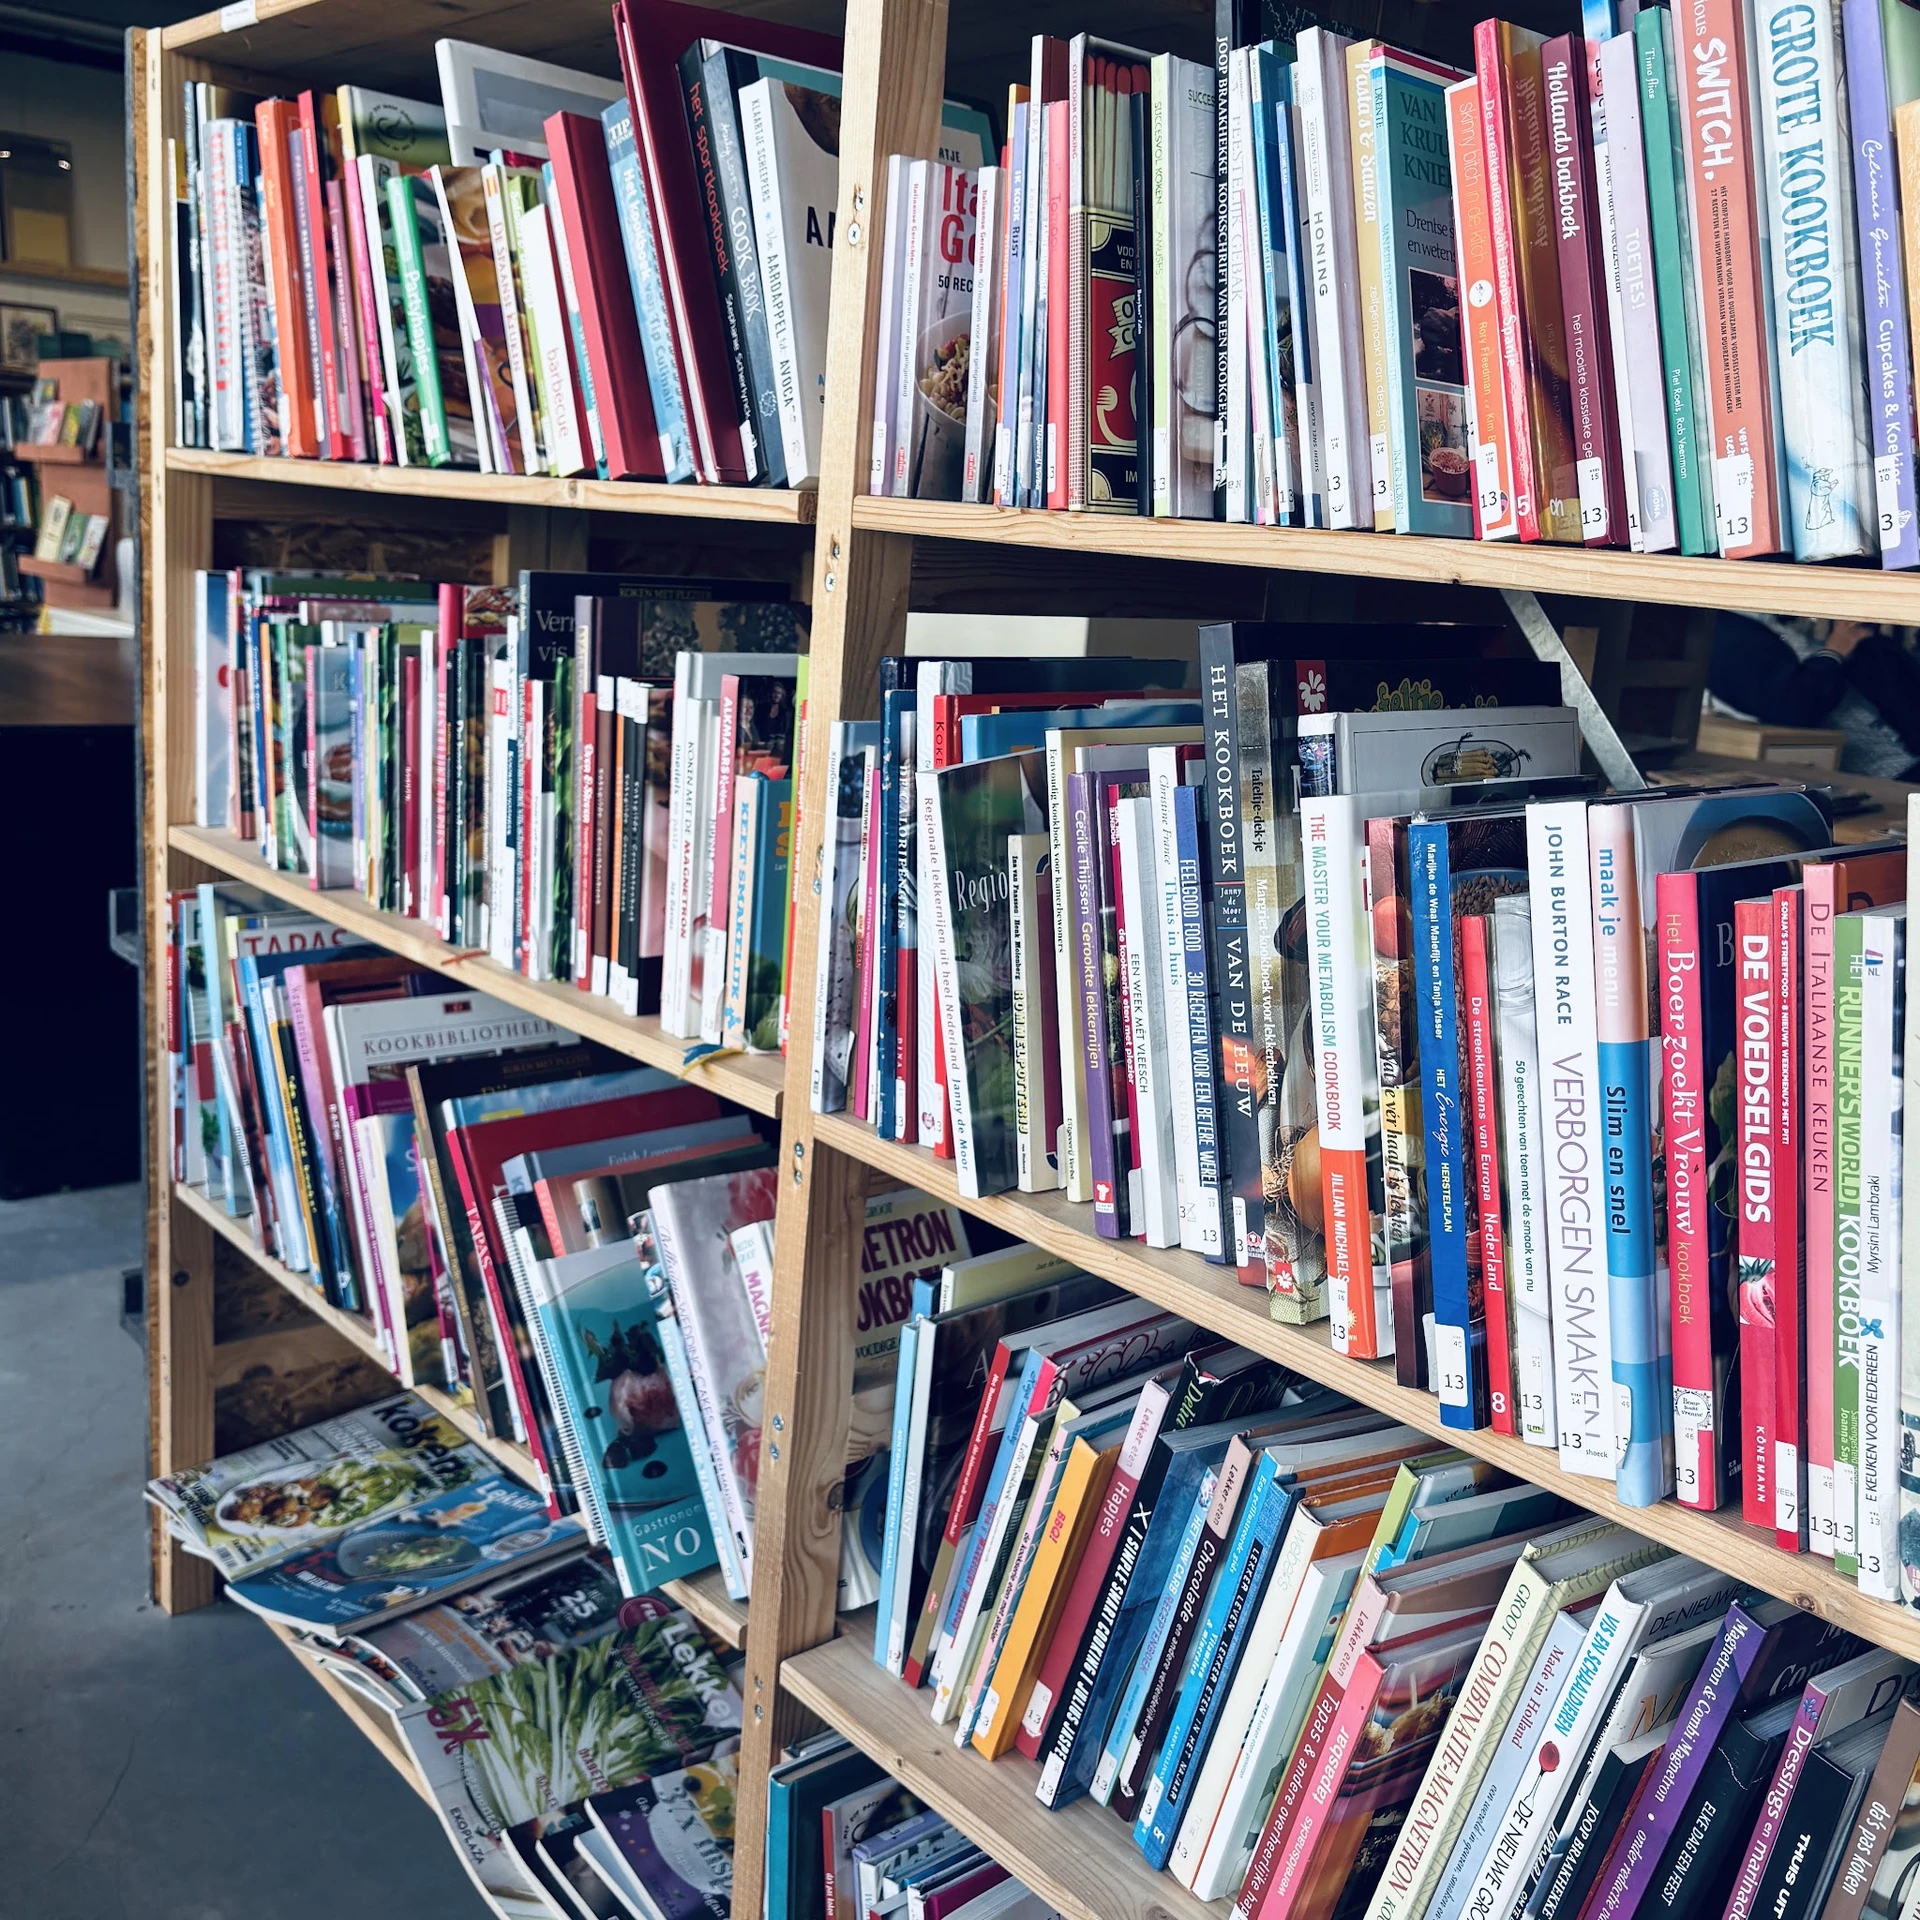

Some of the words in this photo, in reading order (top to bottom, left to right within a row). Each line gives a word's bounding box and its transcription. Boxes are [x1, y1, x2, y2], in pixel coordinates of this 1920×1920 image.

[1216, 35, 1229, 73] JOOP
[1769, 3, 1822, 136] GROTE
[1217, 78, 1229, 176] BRAAKHEKKE
[1485, 99, 1495, 117] De
[1547, 61, 1573, 153] Hollands
[1154, 101, 1163, 165] SUCCESVOL
[1358, 132, 1372, 150] &
[696, 122, 729, 277] sportkookboek
[1155, 174, 1163, 205] KOKEN
[1358, 154, 1378, 224] Sauzen
[1555, 157, 1581, 240] bakboek
[1862, 139, 1884, 220] Culinair
[730, 206, 752, 271] COOK
[1216, 182, 1228, 286] KOOKSCHRIFT
[1406, 209, 1448, 238] Drentse
[1720, 199, 1729, 231] COMPLETE
[1313, 211, 1329, 297] HONING
[1625, 228, 1646, 310] TOETJES!
[1723, 231, 1732, 267] HANDBOEK
[1778, 138, 1836, 358] KOOKBOEK
[740, 275, 763, 322] BOOK
[1217, 290, 1228, 315] VAN
[1217, 320, 1228, 344] EEN
[1571, 314, 1583, 337] het
[1573, 338, 1588, 386] mooiste
[1878, 318, 1897, 401] Cupcakes
[547, 346, 569, 438] barbecue
[1217, 349, 1228, 422] KOOKGEK
[1578, 387, 1593, 438] klassieke
[1881, 404, 1900, 419] &
[1517, 495, 1530, 517] 5
[1581, 508, 1603, 525] 13
[1726, 517, 1749, 536] 13
[1210, 664, 1229, 719] HET
[935, 721, 945, 765] KOKE
[1214, 729, 1237, 874] KOOKBOEK
[1251, 768, 1264, 852] Tafeltje-dek-je
[924, 797, 941, 865] Regionale
[1311, 814, 1326, 841] THE
[1544, 825, 1565, 878] JOHN
[955, 864, 1009, 912] Regio
[1078, 855, 1090, 915] Thijssen
[1178, 858, 1200, 918] FEELGOOD
[1220, 888, 1242, 898] Janny
[1311, 847, 1329, 905] MASTER
[1599, 848, 1619, 908] maak
[930, 865, 946, 951] lekkernijen
[1164, 878, 1175, 925] Thuis
[1551, 886, 1569, 966] BURTON
[1598, 912, 1621, 936] je
[1810, 902, 1830, 937] DE
[1167, 931, 1177, 951] in
[1184, 922, 1202, 951] FOOD
[1315, 910, 1331, 948] YOUR
[1666, 914, 1682, 944] Het
[939, 949, 948, 966] uit
[1082, 922, 1094, 987] Gerookte
[1131, 954, 1140, 976] EEN
[1169, 953, 1182, 985] huis
[1226, 937, 1244, 989] VAN
[1601, 946, 1620, 1007] menu
[1742, 934, 1769, 980] DE
[1781, 938, 1789, 999] STREETFOOD
[1867, 967, 1880, 977] NL
[942, 971, 953, 998] heel
[1133, 981, 1142, 1012] WEEK
[1317, 951, 1336, 1047] METABOLISM
[1471, 996, 1482, 1015] De
[1556, 976, 1572, 1024] RACE
[1666, 949, 1695, 1031] Boer
[363, 1021, 559, 1056] KOOKBIBLIOTHEEK
[945, 1002, 960, 1070] Nederland
[1086, 990, 1101, 1069] lekkernijen
[1230, 1001, 1247, 1034] DE
[1781, 1012, 1790, 1050] NIEUWE
[1811, 952, 1831, 1088] ITALIAANSE
[1137, 1043, 1148, 1093] VLEESCH
[1233, 1044, 1252, 1118] EEUW
[1323, 1051, 1341, 1131] COOKBOOK
[1436, 1069, 1446, 1089] HET
[1471, 1020, 1487, 1120] streekkeukens
[1515, 1060, 1525, 1074] 50
[1662, 1032, 1700, 1127] zoekt
[951, 1078, 963, 1115] Janny
[1515, 1076, 1526, 1129] gerechten
[1604, 1084, 1626, 1132] Slim
[1743, 991, 1772, 1225] VOEDSELGIDS
[1433, 1092, 1455, 1157] Energie
[1479, 1123, 1488, 1148] van
[1518, 1131, 1526, 1150] van
[1812, 1102, 1829, 1194] KEUKEN
[959, 1139, 969, 1170] Moor
[1481, 1154, 1492, 1201] Europa
[1520, 1152, 1528, 1178] toen
[1552, 1051, 1593, 1275] VERBORGEN
[1607, 1142, 1626, 1173] en
[1330, 1172, 1346, 1210] JILLIAN
[1441, 1163, 1453, 1233] HERSTELPLAN
[1521, 1180, 1530, 1200] met
[1673, 1127, 1704, 1236] Vrouw
[1865, 1174, 1881, 1225] Lambraki
[1610, 1185, 1631, 1234] snel
[465, 1204, 493, 1272] TAPAS
[1331, 1212, 1350, 1284] MICHAELS
[1483, 1212, 1503, 1291] Nederland
[1523, 1220, 1533, 1254] smaak
[1865, 1226, 1881, 1275] Myrsini
[1525, 1255, 1534, 1276] van
[1526, 1278, 1534, 1292] nu
[1677, 1241, 1694, 1326] kookboek
[1837, 1214, 1860, 1370] KOOKBOEK
[1865, 1343, 1879, 1406] IEDEREEN
[1175, 1380, 1205, 1430] Delia
[1491, 1391, 1506, 1413] 8
[1864, 1408, 1878, 1444] VOOR
[1755, 1424, 1767, 1503] KÖNEMANN
[1864, 1447, 1879, 1491] KEUKEN
[1099, 1481, 1130, 1537] Hapjes
[1115, 1536, 1140, 1586] SIMPLE
[1180, 1539, 1215, 1623] Chocolade
[1101, 1581, 1124, 1627] SMART
[1505, 1583, 1531, 1641] GROOT
[1602, 1612, 1621, 1634] VIS
[1084, 1621, 1110, 1676] COOKING
[1539, 1644, 1565, 1680] Made
[1604, 1634, 1621, 1652] EN
[1708, 1618, 1749, 1689] Magnetron
[1067, 1681, 1089, 1725] JULIUS
[1553, 1650, 1602, 1737] SCHAALDIEREN
[1511, 1698, 1542, 1750] Holland
[1685, 1699, 1711, 1743] Combi
[1311, 1725, 1351, 1806] tapasbar
[1388, 1639, 1508, 1901] COMBINATIE-MAGNETRON
[1654, 1740, 1694, 1803] Magnetron
[1766, 1725, 1813, 1820] Dressings
[451, 1806, 485, 1865] EKOPLAZA
[1760, 1822, 1773, 1838] en
[1868, 1800, 1891, 1831] da's
[1276, 1816, 1314, 1896] wereldsnacks
[1857, 1829, 1878, 1858] pas
[1842, 1858, 1872, 1896] koken
